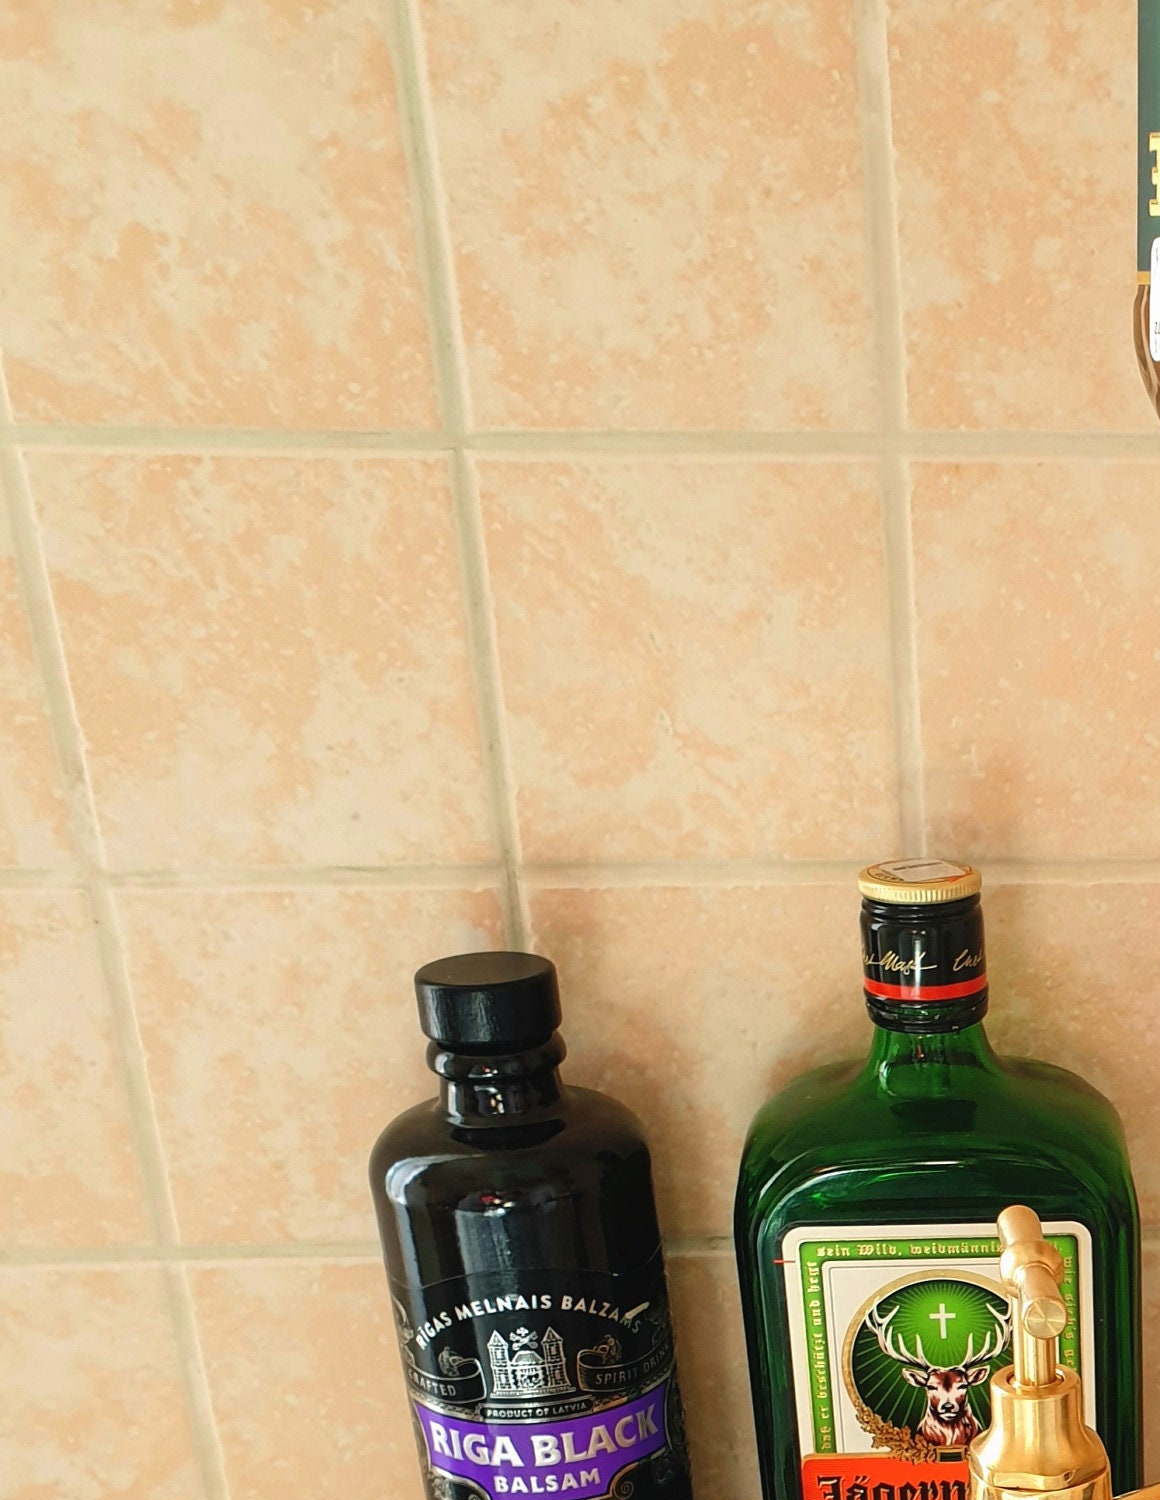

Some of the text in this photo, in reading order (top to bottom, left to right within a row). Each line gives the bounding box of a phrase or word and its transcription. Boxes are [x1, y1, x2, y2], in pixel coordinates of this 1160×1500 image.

[816, 1243, 851, 1258] sein
[454, 1294, 553, 1321] MELNAIS
[561, 1295, 643, 1334] BALZAMS
[595, 1369, 640, 1386] SPIRIT
[486, 1402, 588, 1419] PRODUCT OF LATVIA
[429, 1404, 660, 1468] RIGA BLACK
[493, 1467, 601, 1494] BALSAM
